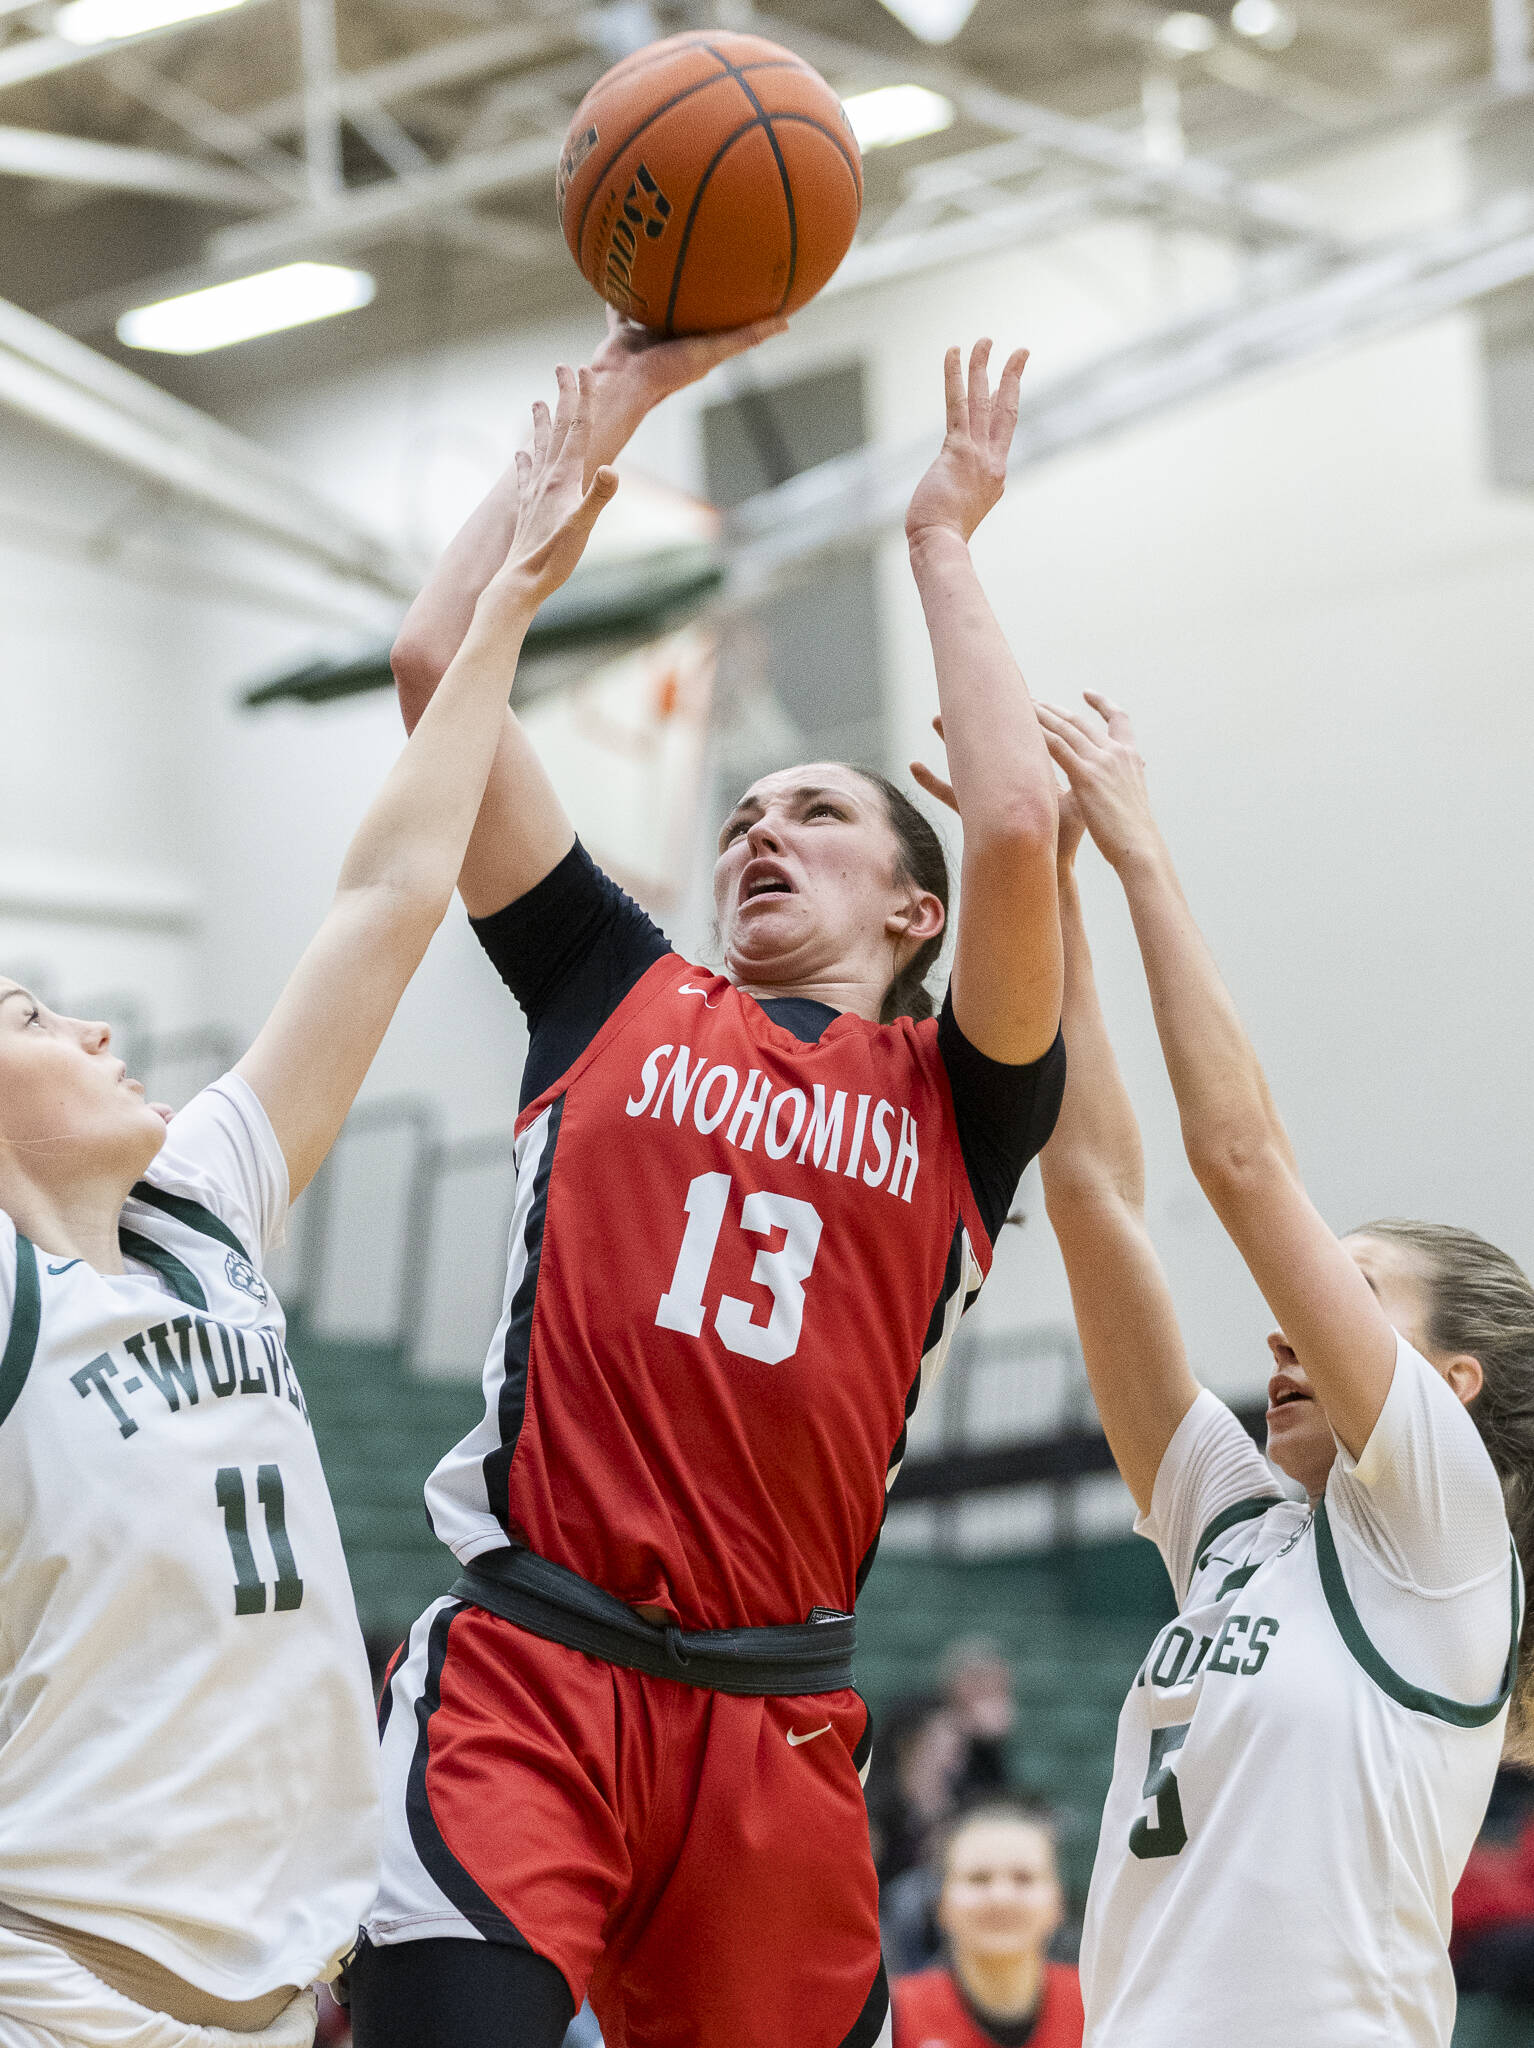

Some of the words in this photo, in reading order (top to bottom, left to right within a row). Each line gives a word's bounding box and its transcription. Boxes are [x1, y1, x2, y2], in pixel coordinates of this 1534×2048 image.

[625, 1044, 919, 1204] SNOHOMISH
[654, 1170, 824, 1366] 13
[215, 1463, 304, 1616] 11
[1128, 1721, 1192, 1860] 5
